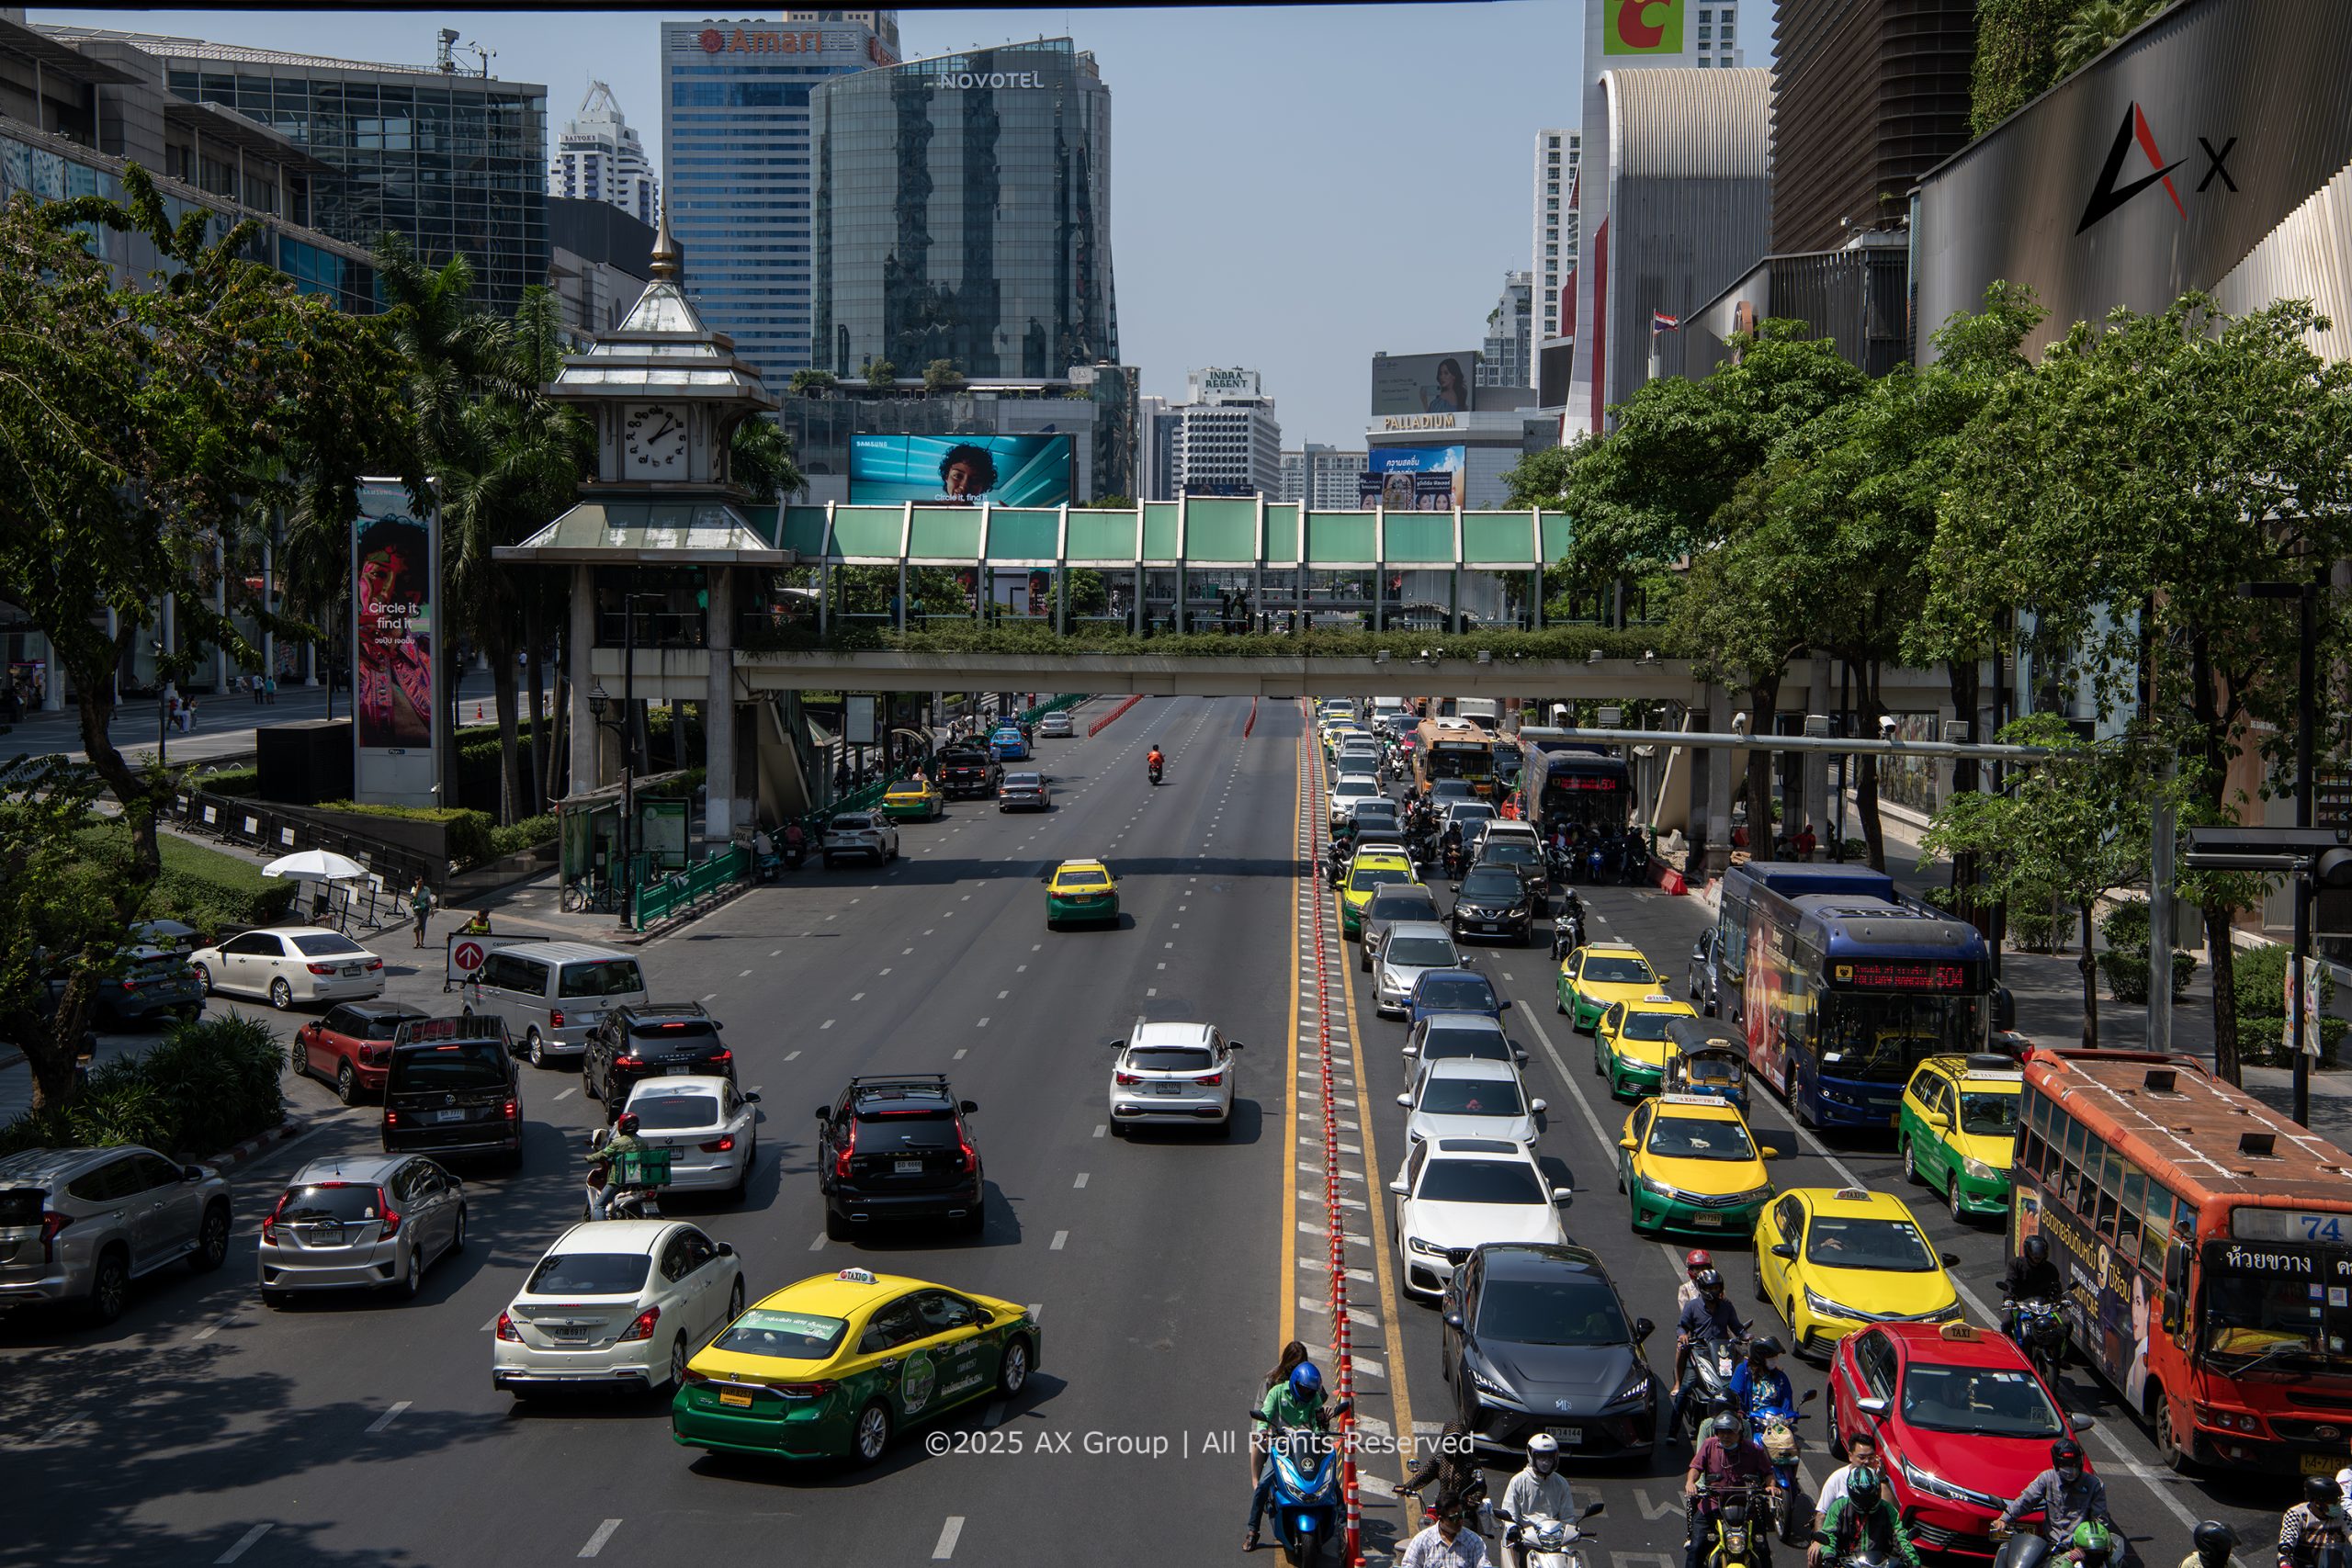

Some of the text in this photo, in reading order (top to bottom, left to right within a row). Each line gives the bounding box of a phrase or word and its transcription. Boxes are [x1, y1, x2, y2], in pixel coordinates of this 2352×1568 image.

[727, 28, 822, 53] Amari
[941, 70, 1045, 89] NOVOTEL
[1210, 371, 1242, 379] INDRA
[1205, 379, 1248, 388] REGENT
[1385, 413, 1455, 431] PALLADIUM
[967, 493, 981, 502] find
[369, 602, 420, 615] Circle it,
[377, 617, 413, 629] find it
[1601, 778, 1617, 790] 504
[1936, 966, 1963, 987] 504
[1846, 1190, 1860, 1199] TAXI
[2301, 1216, 2345, 1242] 74
[2041, 1205, 2097, 1270] ยอดขายอันดับหนึ่ง
[2098, 1244, 2109, 1290] 9
[2109, 1262, 2131, 1304] ปีซ้อน
[2225, 1246, 2312, 1273] ห้วยขวาง
[2336, 1259, 2352, 1276] ค
[848, 1271, 861, 1281] TAXI
[1951, 1327, 1971, 1337] TAXI
